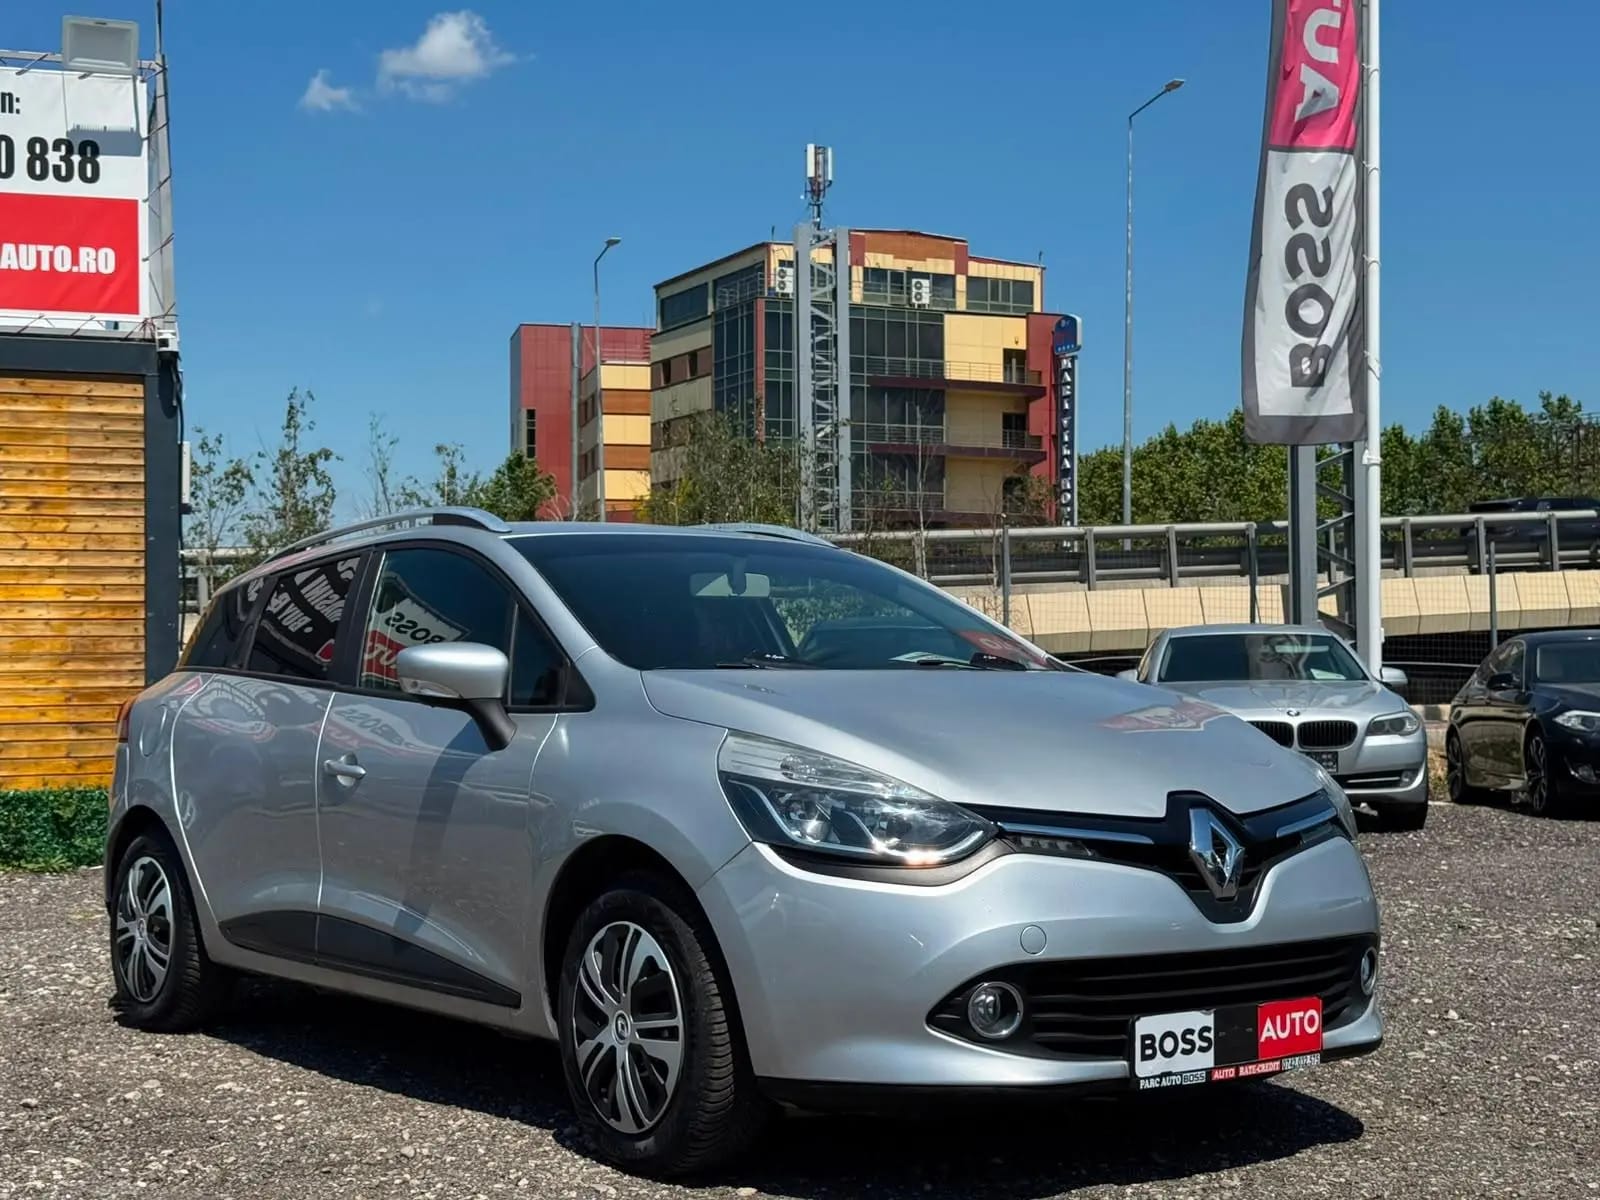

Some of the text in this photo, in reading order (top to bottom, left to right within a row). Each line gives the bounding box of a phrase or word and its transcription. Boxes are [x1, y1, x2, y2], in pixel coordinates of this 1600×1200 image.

[26, 136, 100, 184] 838
[0, 243, 116, 275] AUTO.RO
[1259, 1009, 1320, 1043] AUTO
[1140, 1025, 1213, 1062] BOSS
[1139, 1072, 1206, 1090] PARC AUTO BOSS
[1213, 1068, 1235, 1080] AUTO
